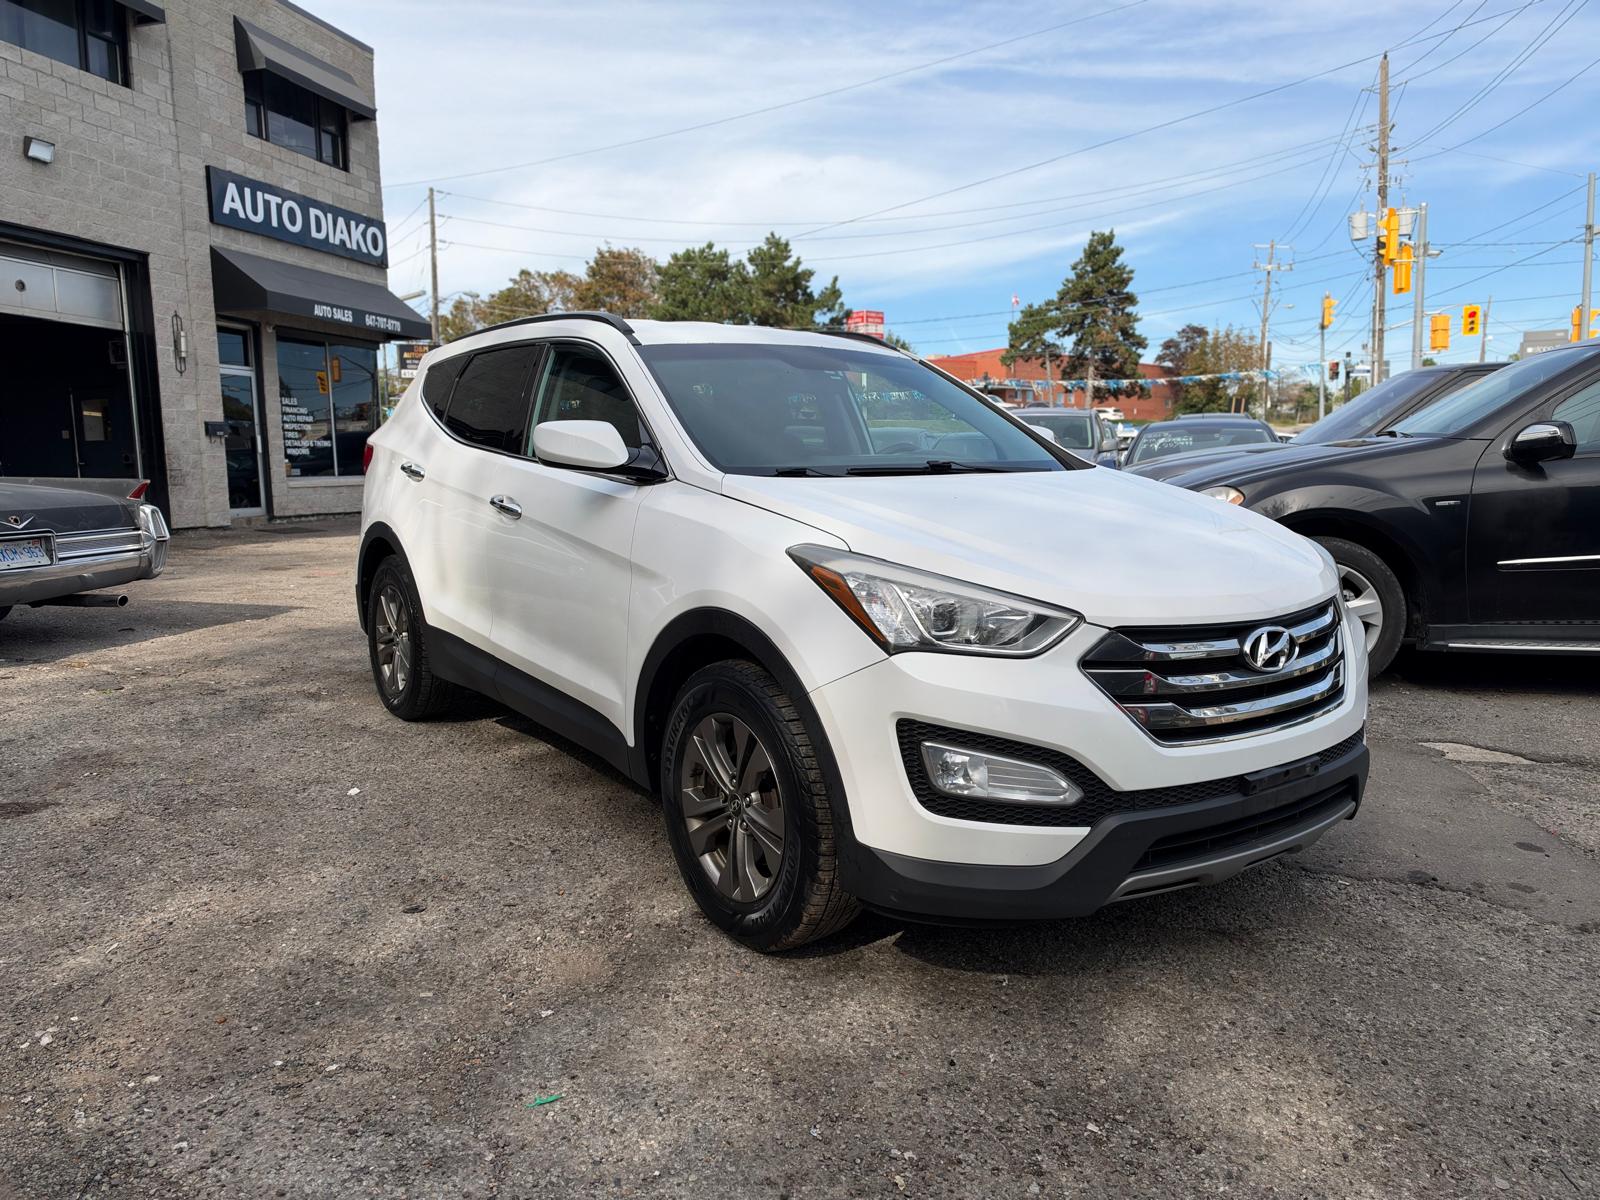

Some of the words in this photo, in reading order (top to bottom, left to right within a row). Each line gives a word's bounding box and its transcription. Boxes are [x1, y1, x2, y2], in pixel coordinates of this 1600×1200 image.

[222, 182, 303, 233] AUTO
[309, 207, 384, 257] DIAKO
[314, 303, 332, 318] AUTO
[332, 307, 353, 323] SALES
[281, 397, 298, 405] SALES
[285, 439, 309, 447] DETAILING
